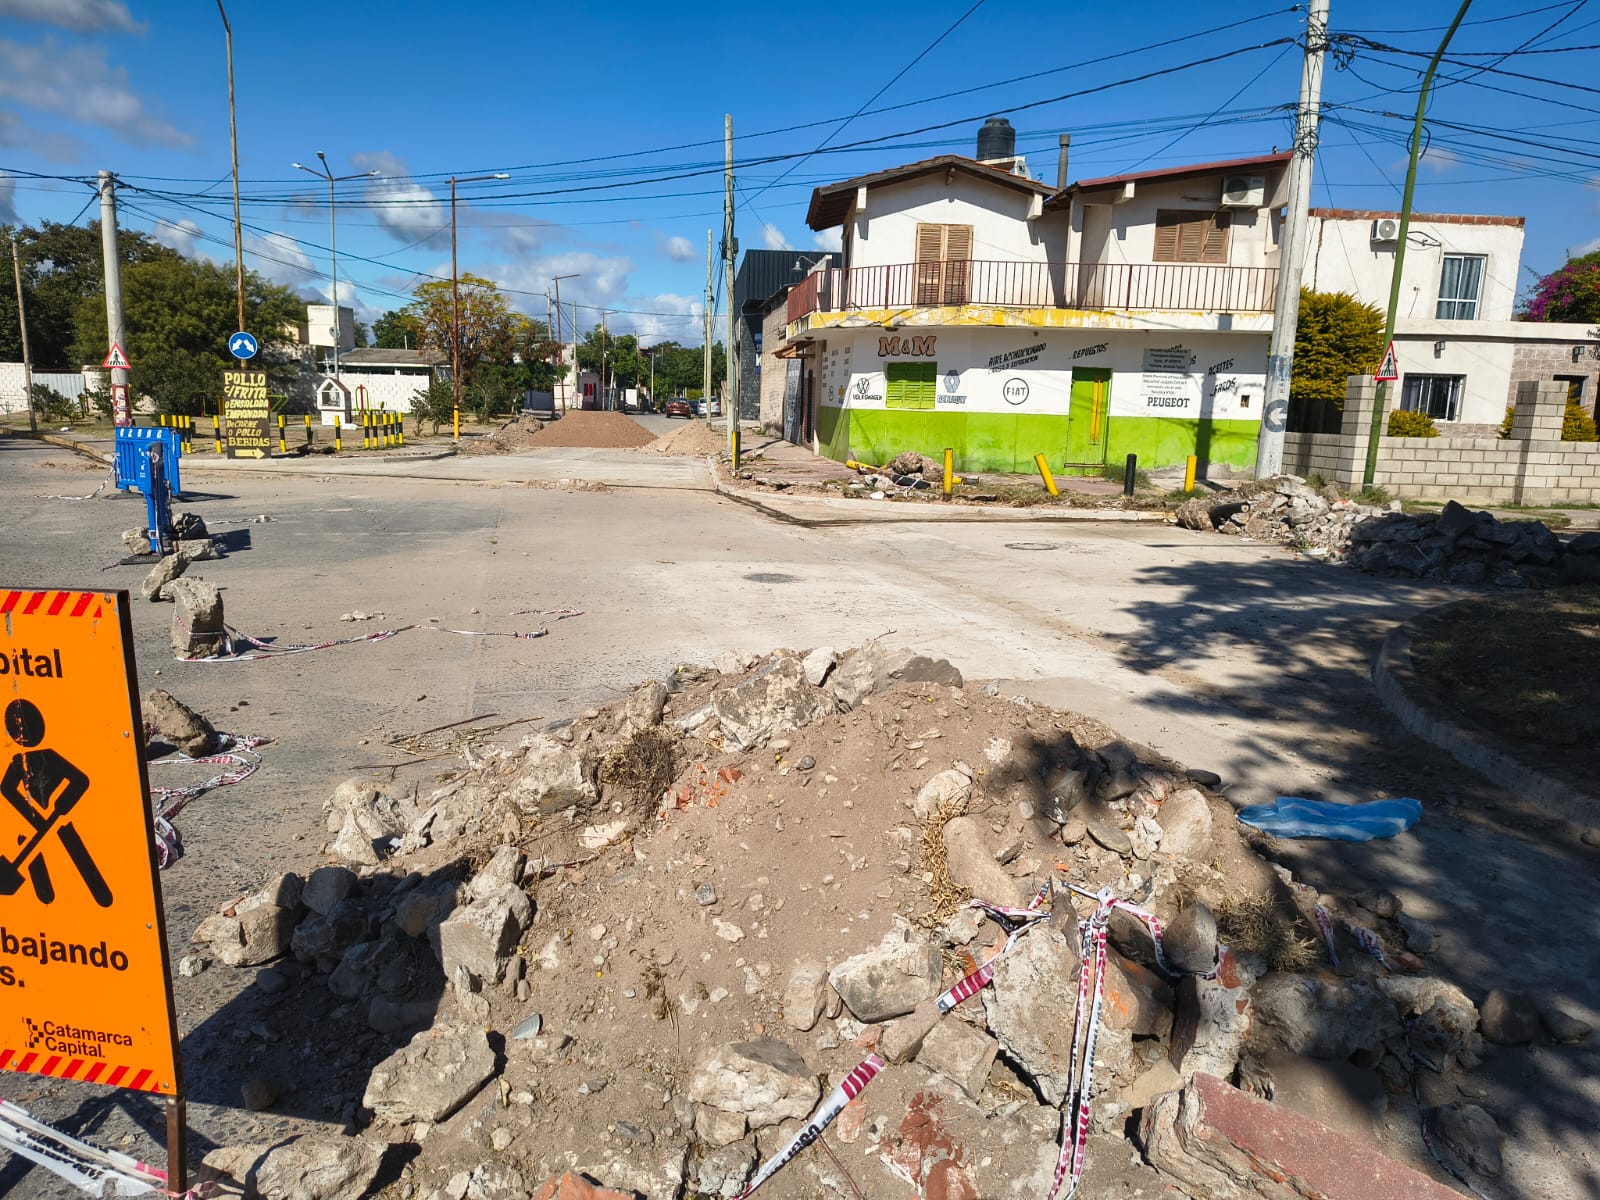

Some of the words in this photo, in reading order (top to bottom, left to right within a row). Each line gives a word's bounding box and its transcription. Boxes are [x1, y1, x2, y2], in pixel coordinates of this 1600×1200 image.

[878, 336, 937, 357] M&M
[1072, 343, 1109, 359] REPUESTOS
[1208, 358, 1234, 376] ACEITES
[224, 373, 265, 387] POLLO
[1006, 387, 1026, 397] FIAT
[1147, 397, 1190, 408] PEUGEOT
[229, 437, 270, 446] BEBIDAS
[0, 927, 129, 971] bajando
[43, 1020, 133, 1046] Catamarca
